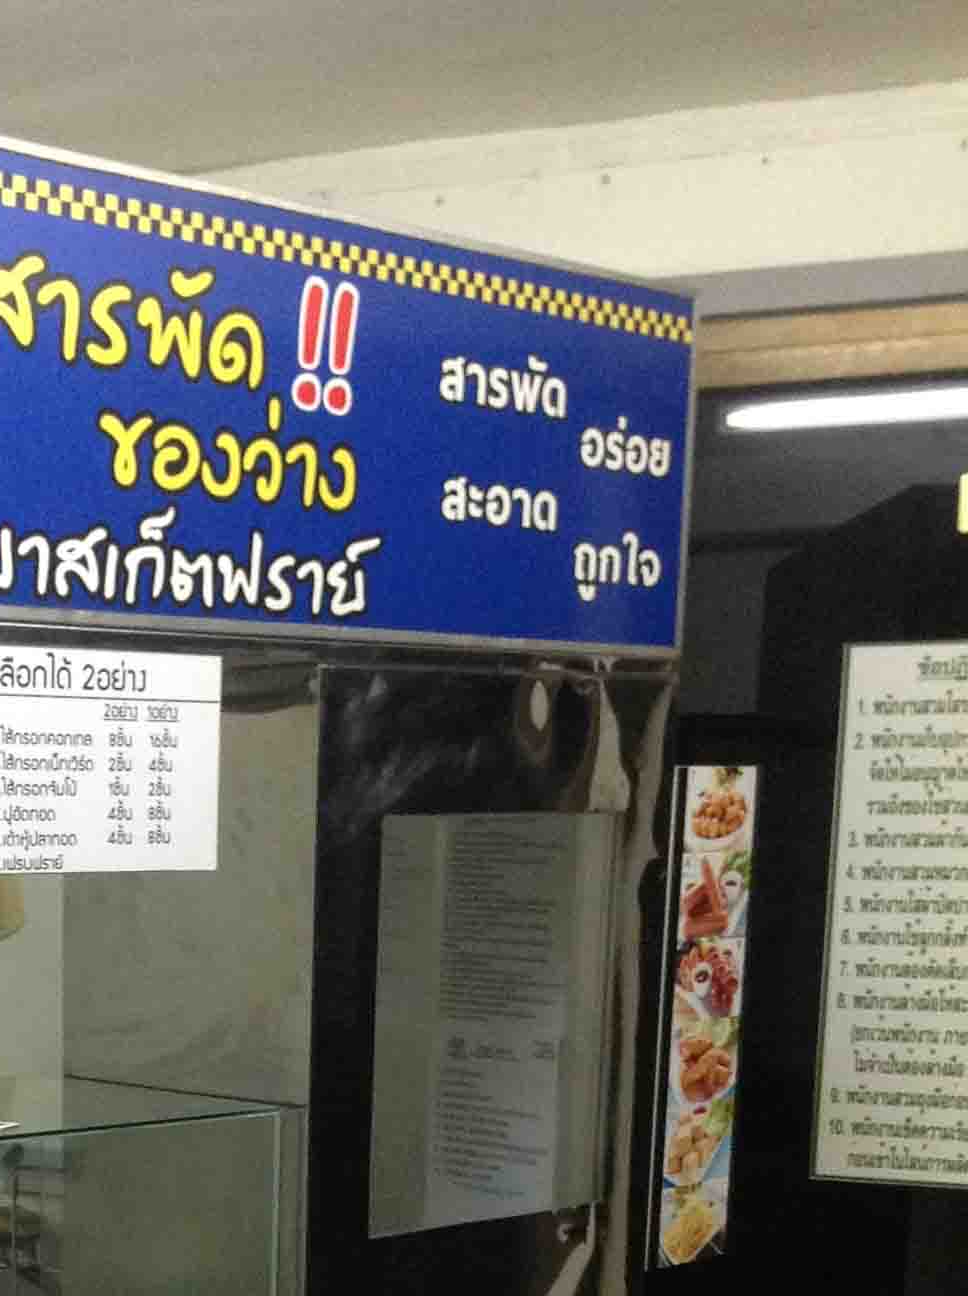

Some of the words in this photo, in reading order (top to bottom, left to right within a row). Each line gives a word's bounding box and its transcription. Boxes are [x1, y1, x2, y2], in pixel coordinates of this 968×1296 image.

[439, 355, 567, 418] สารพัด
[98, 396, 358, 512] ของว่าง
[580, 416, 671, 477] อร่อย
[440, 476, 558, 531] สะอาด
[573, 531, 662, 602] ถูกใจ
[82, 659, 147, 692] 2อย่าง
